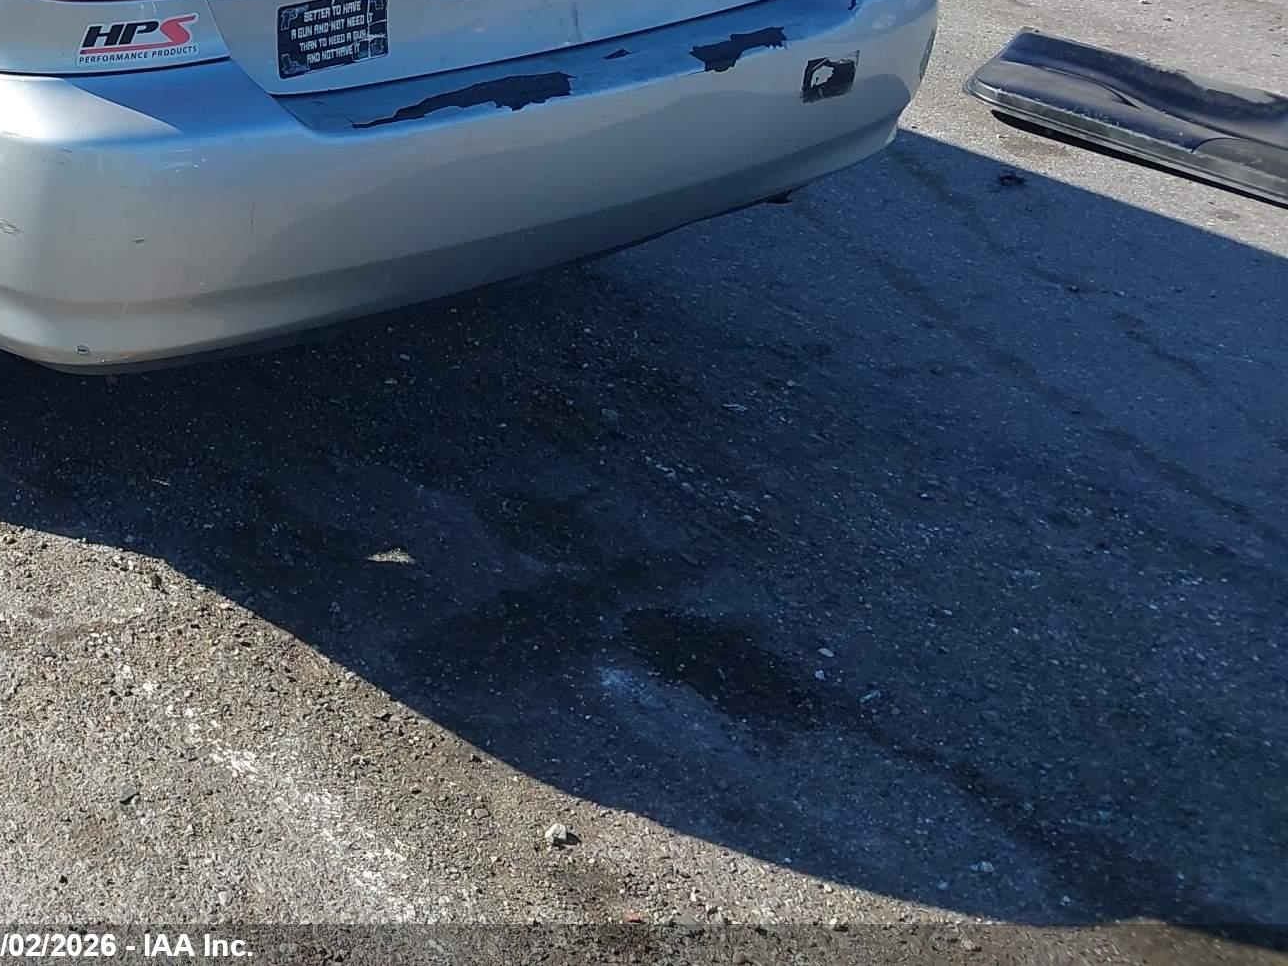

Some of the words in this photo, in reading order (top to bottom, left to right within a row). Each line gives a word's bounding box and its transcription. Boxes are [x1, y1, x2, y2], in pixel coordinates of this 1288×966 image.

[303, 8, 330, 23] BETTER
[332, 4, 342, 17] TO
[342, 0, 362, 15] HAVE
[81, 14, 197, 52] HPS
[291, 29, 297, 40] A
[298, 25, 313, 38] GUN
[314, 22, 329, 34] AND
[331, 19, 345, 32] NOT
[347, 15, 365, 28] NEED
[299, 39, 318, 52] THAN
[318, 37, 327, 48] TO
[328, 34, 345, 46] NEED
[346, 32, 352, 42] A
[306, 52, 320, 64] AND
[322, 49, 336, 61] NOT
[336, 45, 353, 57] HAVE
[353, 42, 360, 54] IT
[79, 51, 148, 65] PERFORMANCE
[151, 45, 198, 59] PRODUCTS
